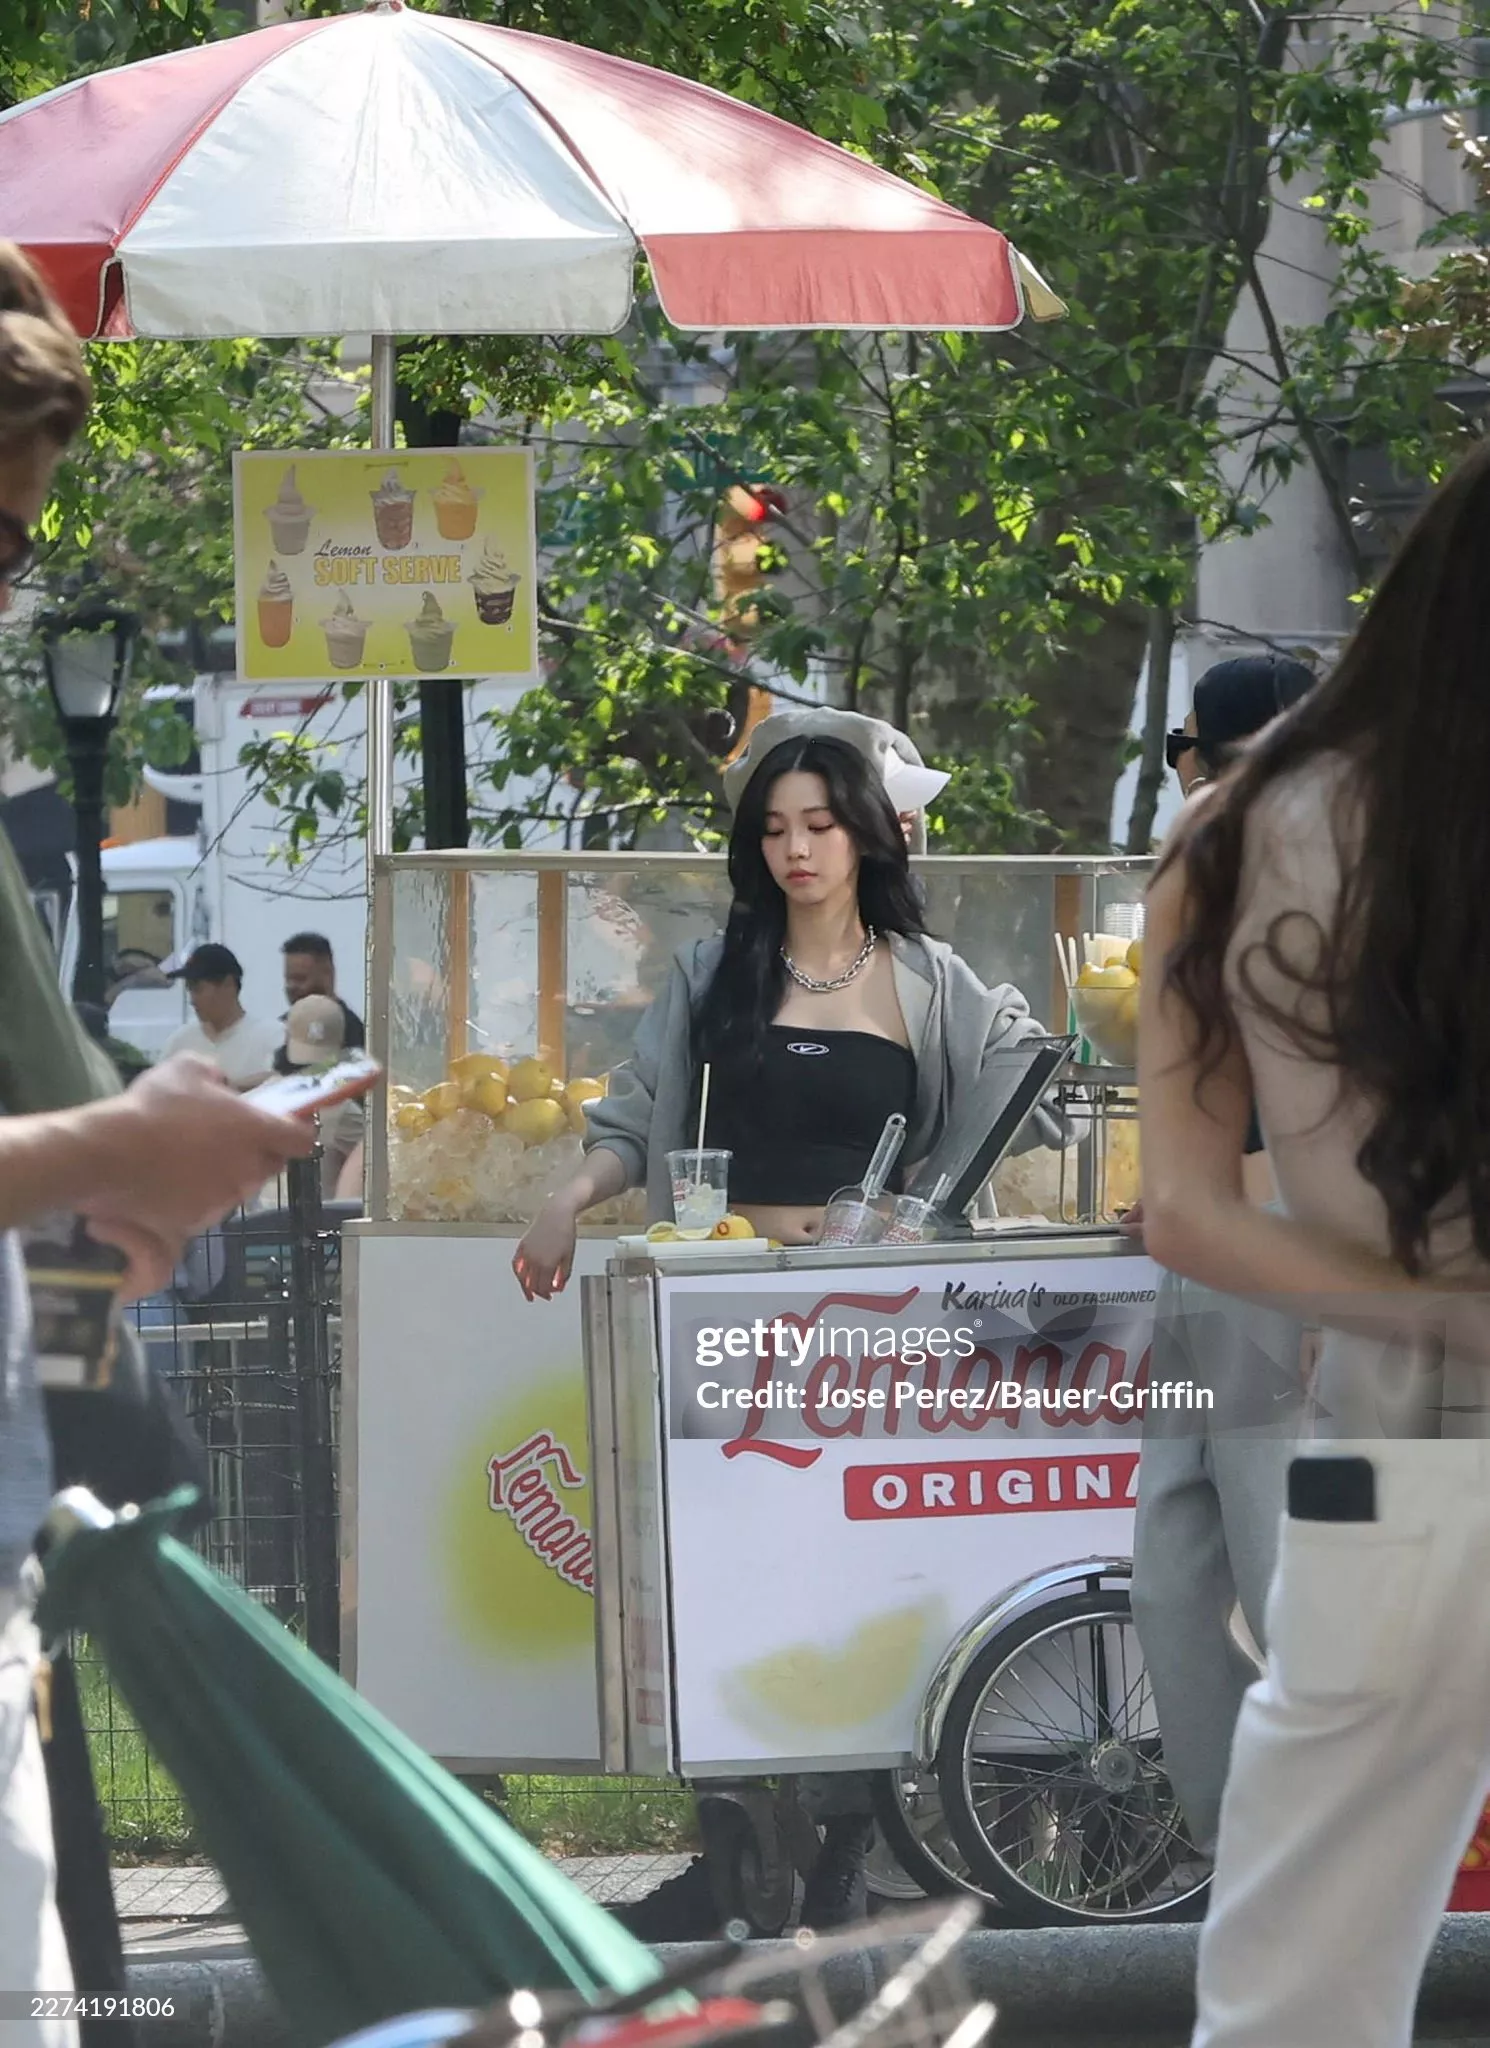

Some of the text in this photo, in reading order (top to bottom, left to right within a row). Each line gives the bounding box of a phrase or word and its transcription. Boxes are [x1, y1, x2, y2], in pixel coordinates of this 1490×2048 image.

[314, 538, 372, 557] Lemon
[314, 555, 462, 587] SOFT SERVE
[1053, 1293, 1079, 1307] OLD
[1082, 1290, 1157, 1305] FASHIONED
[721, 1286, 1154, 1468] Lemona
